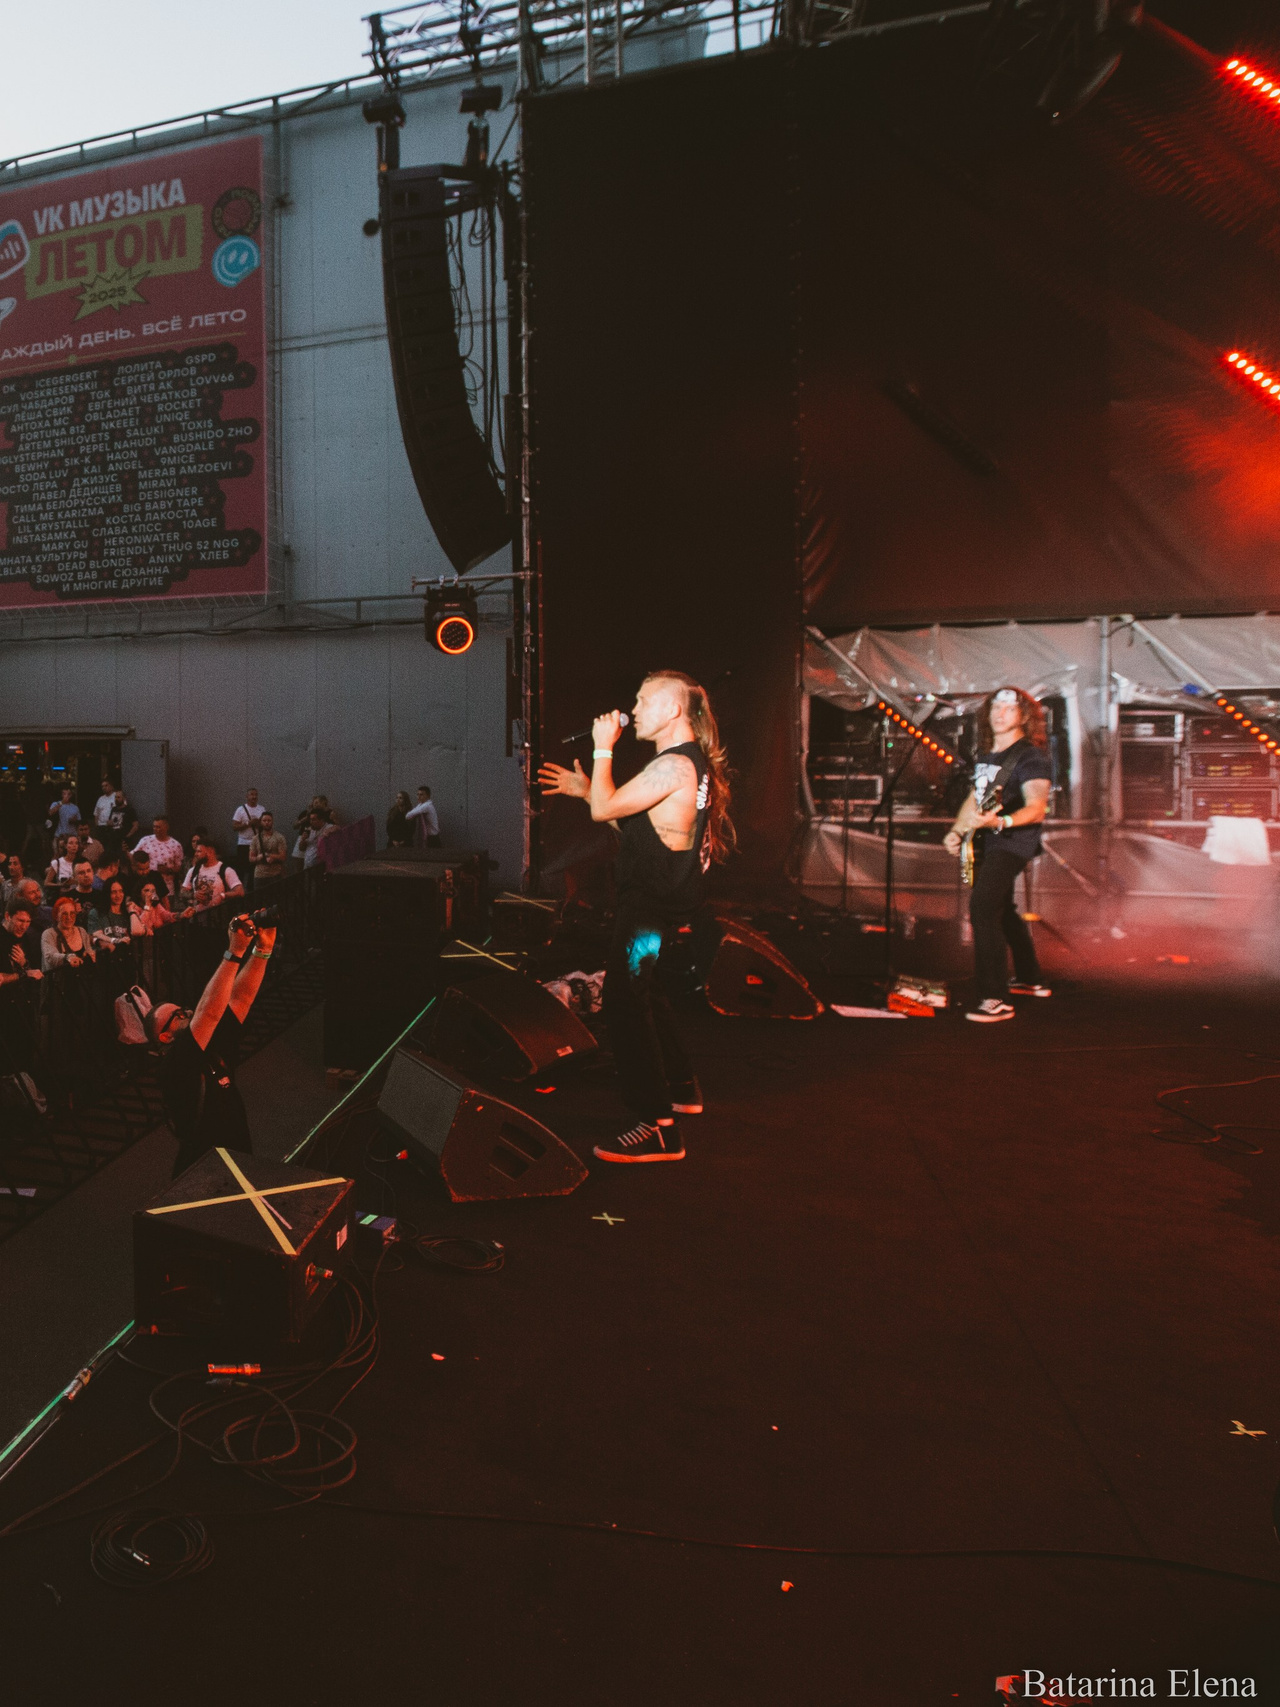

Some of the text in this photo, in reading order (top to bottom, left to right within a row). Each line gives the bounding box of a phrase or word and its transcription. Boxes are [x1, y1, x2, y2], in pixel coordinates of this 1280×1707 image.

[33, 207, 64, 235] VK
[70, 178, 186, 227] МУЗЫКА
[35, 215, 188, 287] ЛЕТОМ
[89, 286, 127, 303] 2025
[79, 326, 135, 349] ДЕНЬ.
[142, 315, 183, 336] ВСЁ
[189, 309, 246, 328] ЛЕТО
[20, 366, 197, 400] VOSKRESENSKII СЕРГЕЙ ОРЛОВ
[35, 370, 99, 388] ICEGERGERT
[117, 361, 162, 375] ЛОЛИТА
[185, 353, 216, 365] GSPD
[21, 395, 75, 410] ЧАБДАРОВ
[90, 390, 111, 400] TGK
[126, 383, 155, 395] ВИТЯ
[190, 372, 234, 386] LOVV66
[45, 406, 73, 417] СВИК
[88, 395, 137, 412] ЕВГЕНИЙ
[140, 388, 197, 404] ЧЕБАТКОВ
[10, 420, 51, 433] АНТОХА
[84, 406, 141, 422] OBLADAET
[157, 398, 202, 412] ROCKET
[20, 428, 66, 441] FORTUNA
[69, 425, 85, 434] 812
[155, 411, 190, 423] UNIQE
[18, 441, 51, 452] ARTEM
[54, 432, 110, 447] SHILOVETS
[126, 425, 164, 438] SALUKI
[80, 442, 110, 454] PEPEL
[114, 437, 156, 450] NAHUDI
[173, 429, 224, 443] BUSHIDO
[228, 426, 253, 438] ZHO
[15, 441, 214, 473] BEWHY SIK-K HAON VANGDALE
[20, 454, 195, 483] SODA LUV KAI ANGEL 9MICE
[32, 481, 58, 491] ЛЕРА
[72, 473, 118, 488] ДЖИЗУС
[138, 467, 176, 479] MERAB
[179, 462, 232, 475] AMZOEVI
[32, 478, 177, 501] ПАВЕЛ ДЕДИЩЕВ MIRAVI
[12, 497, 204, 524] CALL ME KARIZMA BIG BABY TAPE
[14, 486, 198, 513] ТИМА БЕЛОРУССКИХ DESIIGNER
[12, 518, 217, 545] INSTASAMKA СЛАВА КПСС 10AGE
[17, 509, 198, 534] LIL KRYSTALLL КОСТА ЛАКОСТА
[35, 551, 88, 563] КУЛЬТУРЫ
[104, 545, 155, 557] FRIENDLY
[162, 542, 193, 552] THUG
[196, 540, 209, 550] 52
[213, 538, 239, 548] NGG
[41, 532, 180, 552] MARY GU HERONWATER
[31, 564, 42, 573] 52
[57, 561, 86, 572] DEAD
[89, 557, 132, 570] BLONDE
[148, 554, 183, 564] ANIKV
[200, 550, 229, 561] ХЛЕБ
[36, 565, 170, 584] SQWOZ BAB СЮЗАННА
[62, 576, 164, 592] И МНОГИЕ ДРУГИЕ
